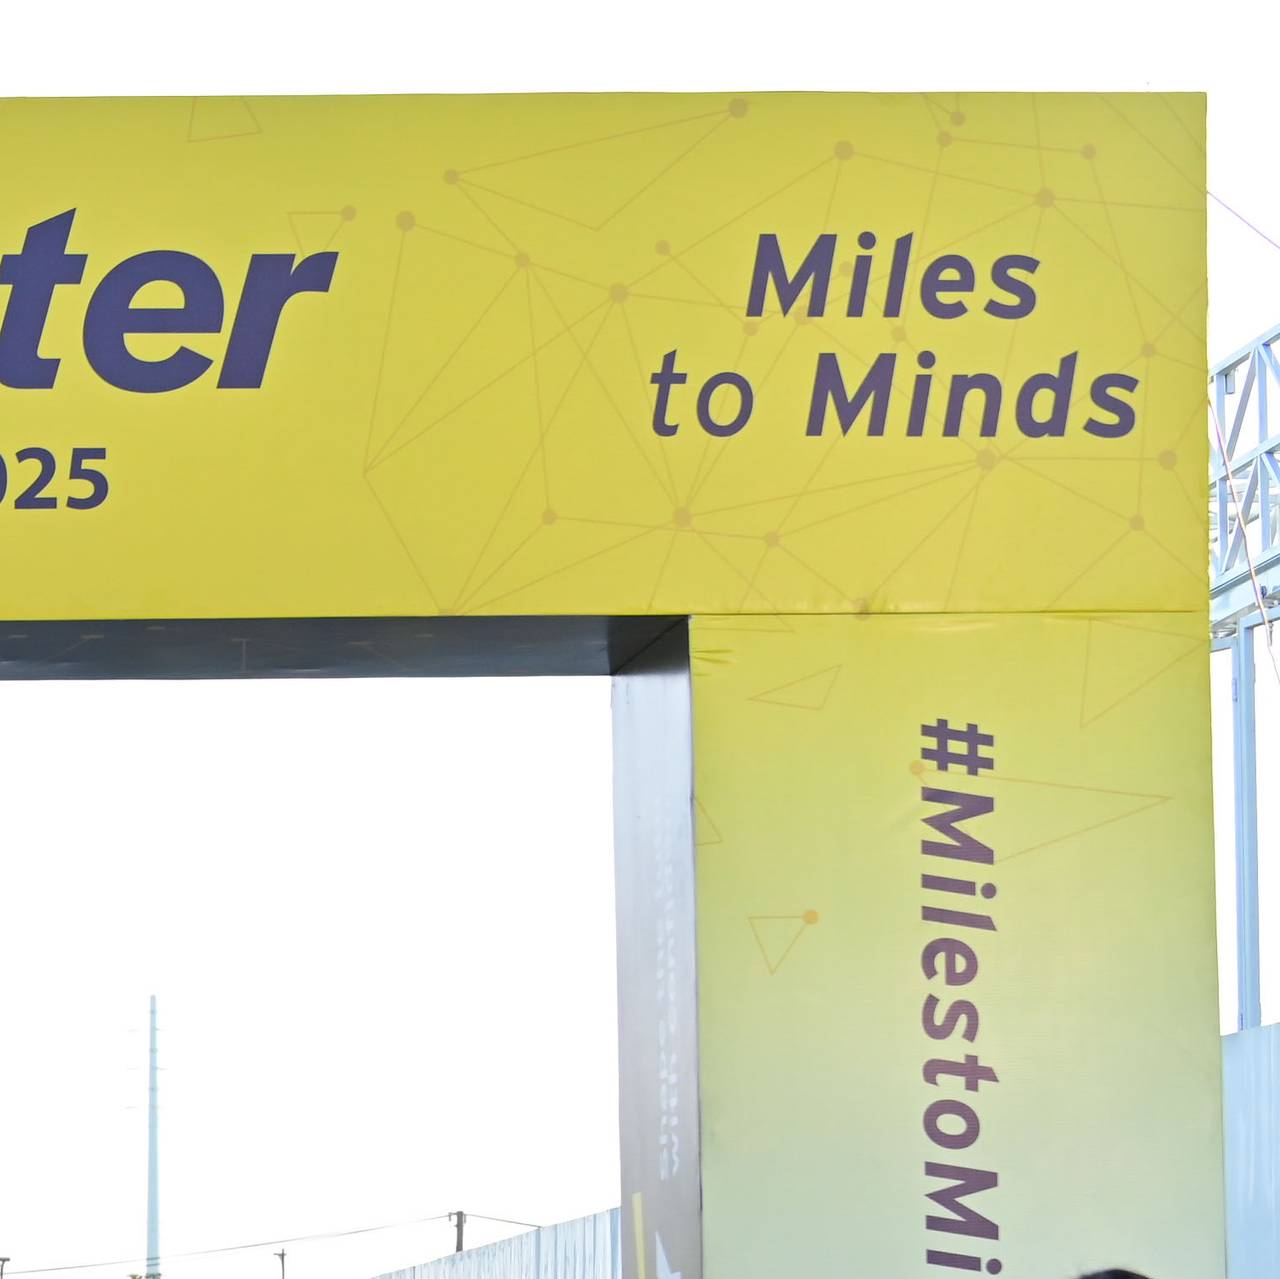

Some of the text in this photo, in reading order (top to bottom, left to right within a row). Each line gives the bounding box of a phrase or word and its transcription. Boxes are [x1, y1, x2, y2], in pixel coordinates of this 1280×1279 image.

[746, 232, 1041, 320] Miles
[650, 349, 1140, 438] to Minds
